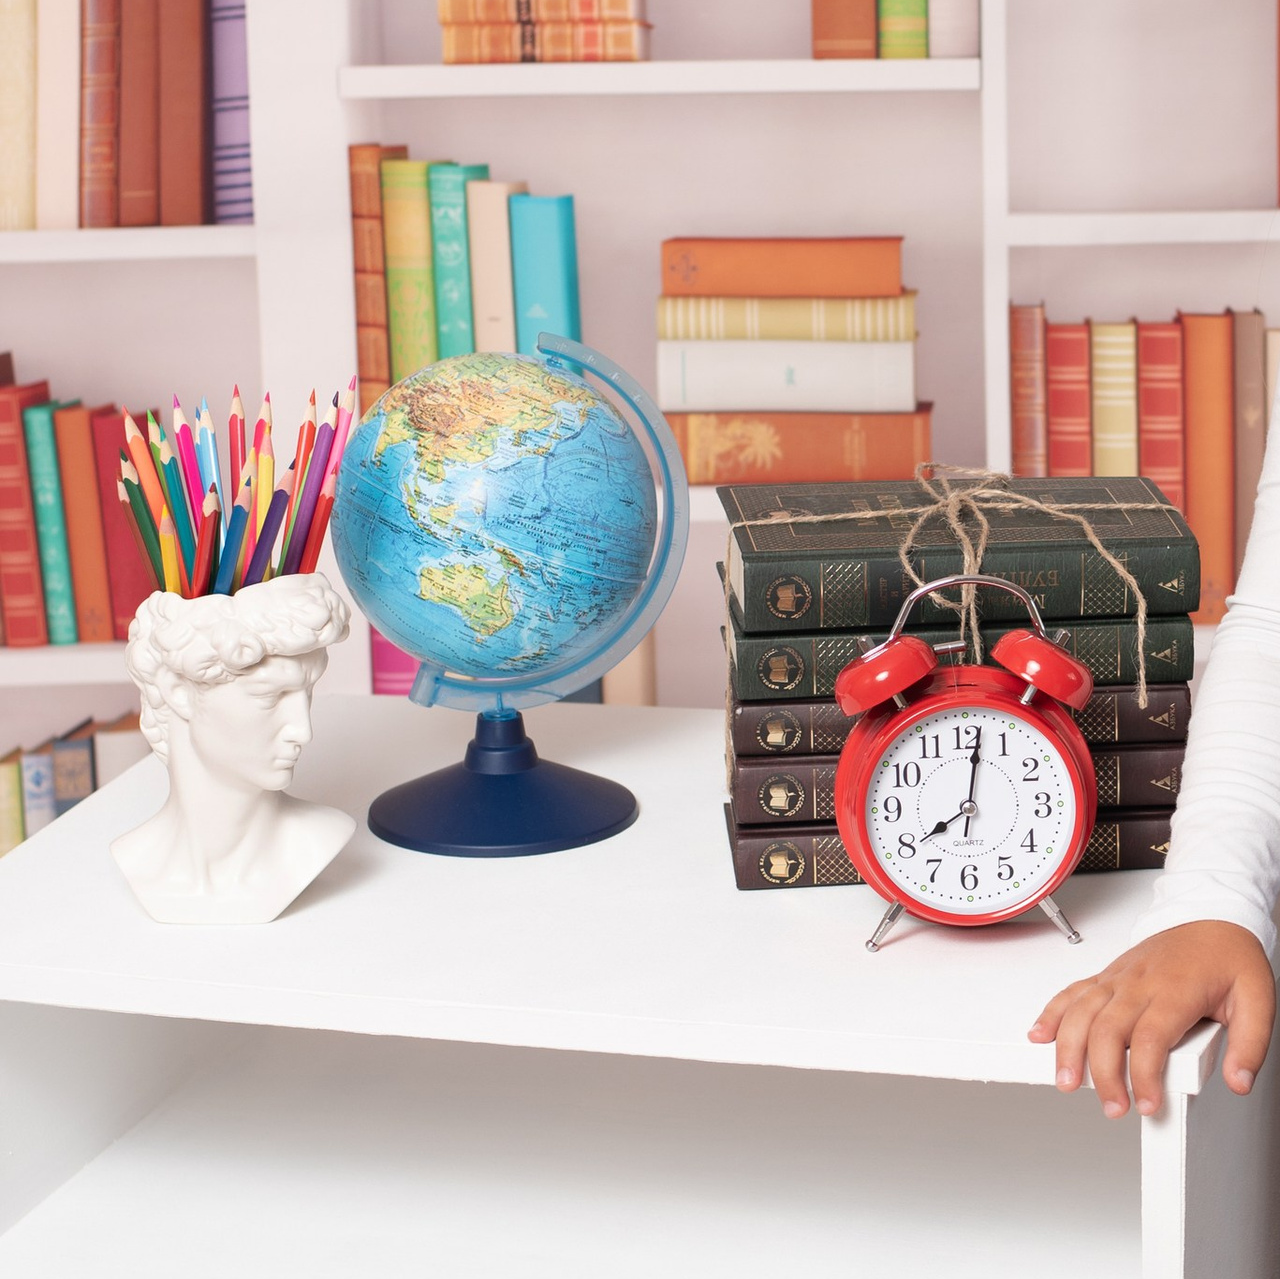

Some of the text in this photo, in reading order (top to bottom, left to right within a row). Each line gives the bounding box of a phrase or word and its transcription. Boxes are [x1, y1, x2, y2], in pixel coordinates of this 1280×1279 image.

[918, 734, 943, 759] 11
[952, 725, 981, 750] 12
[998, 732, 1010, 756] 1
[892, 761, 922, 788] 10
[1022, 757, 1040, 782] 2
[883, 796, 902, 823] 9
[1034, 792, 1052, 818] 3
[897, 833, 916, 859] 8
[952, 839, 985, 848] QUARTZ
[1020, 828, 1038, 853] 4
[926, 858, 943, 883] 7
[960, 864, 979, 891] 6
[997, 855, 1014, 880] 5
